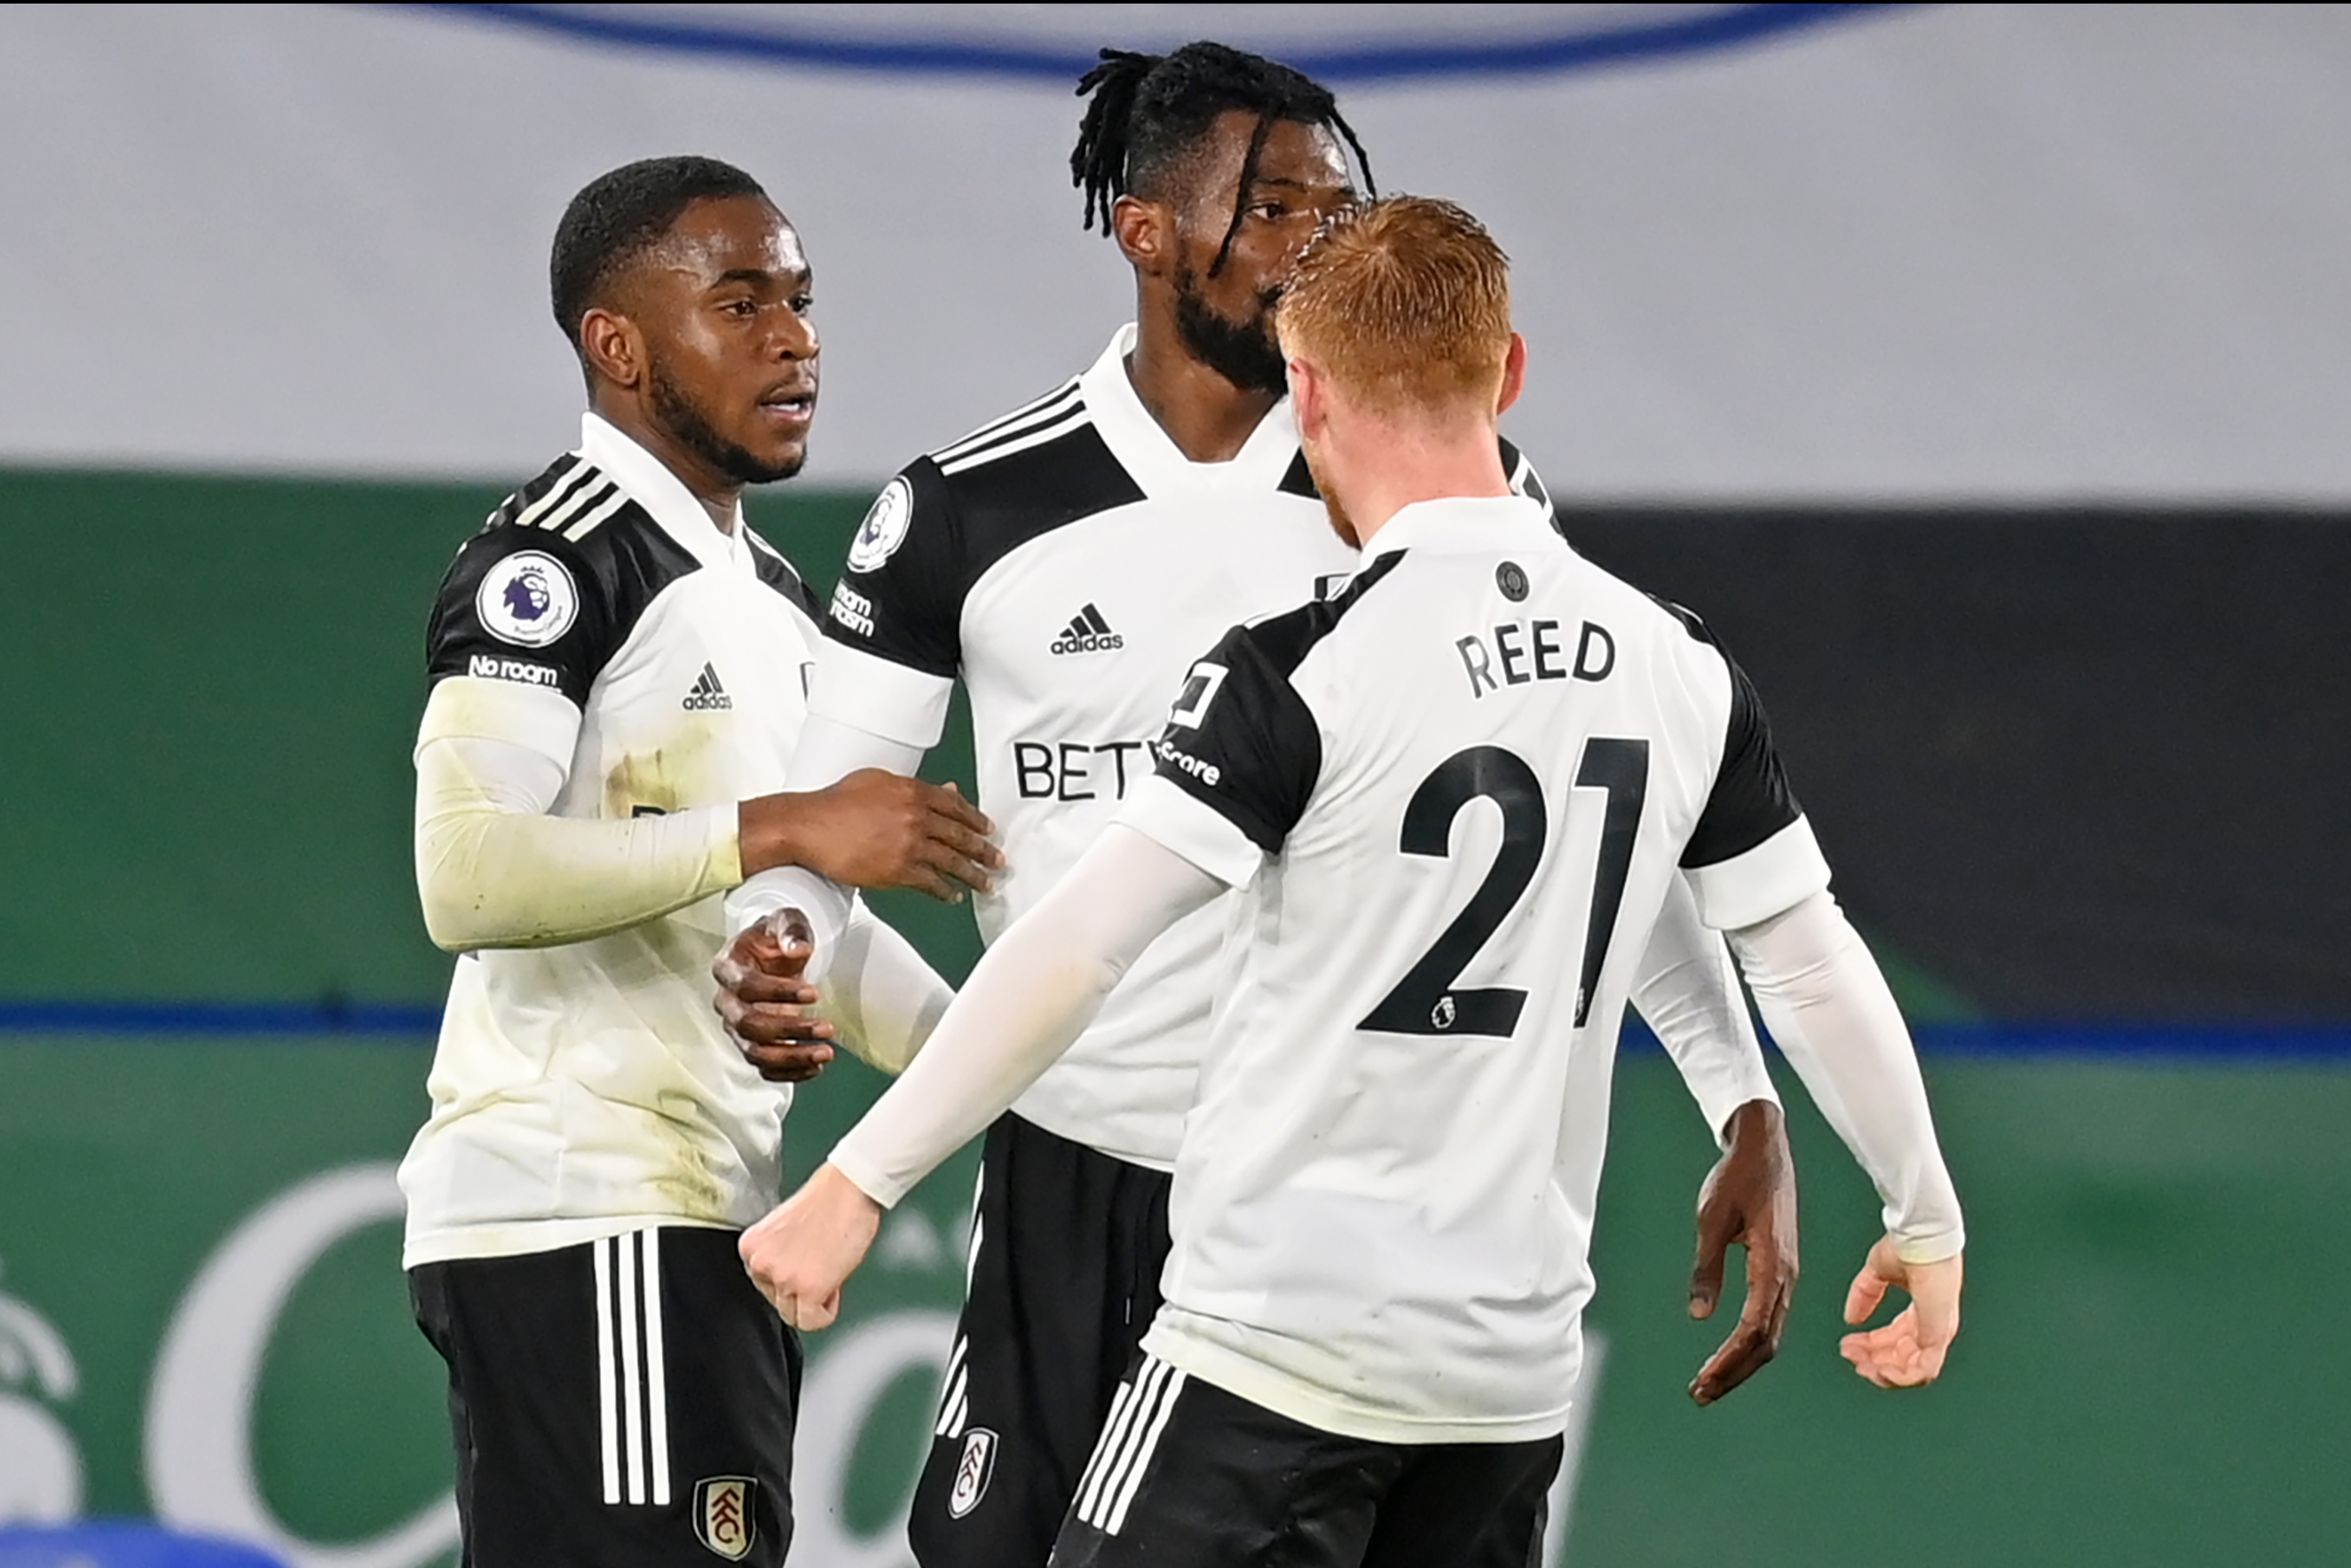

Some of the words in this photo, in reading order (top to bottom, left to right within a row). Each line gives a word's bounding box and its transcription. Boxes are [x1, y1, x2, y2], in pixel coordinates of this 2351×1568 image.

[1050, 634, 1124, 655] adidas
[1456, 619, 1617, 699] REED
[469, 654, 499, 677] No
[500, 660, 558, 685] room
[682, 694, 733, 711] adidas
[1355, 737, 1651, 1039] 21
